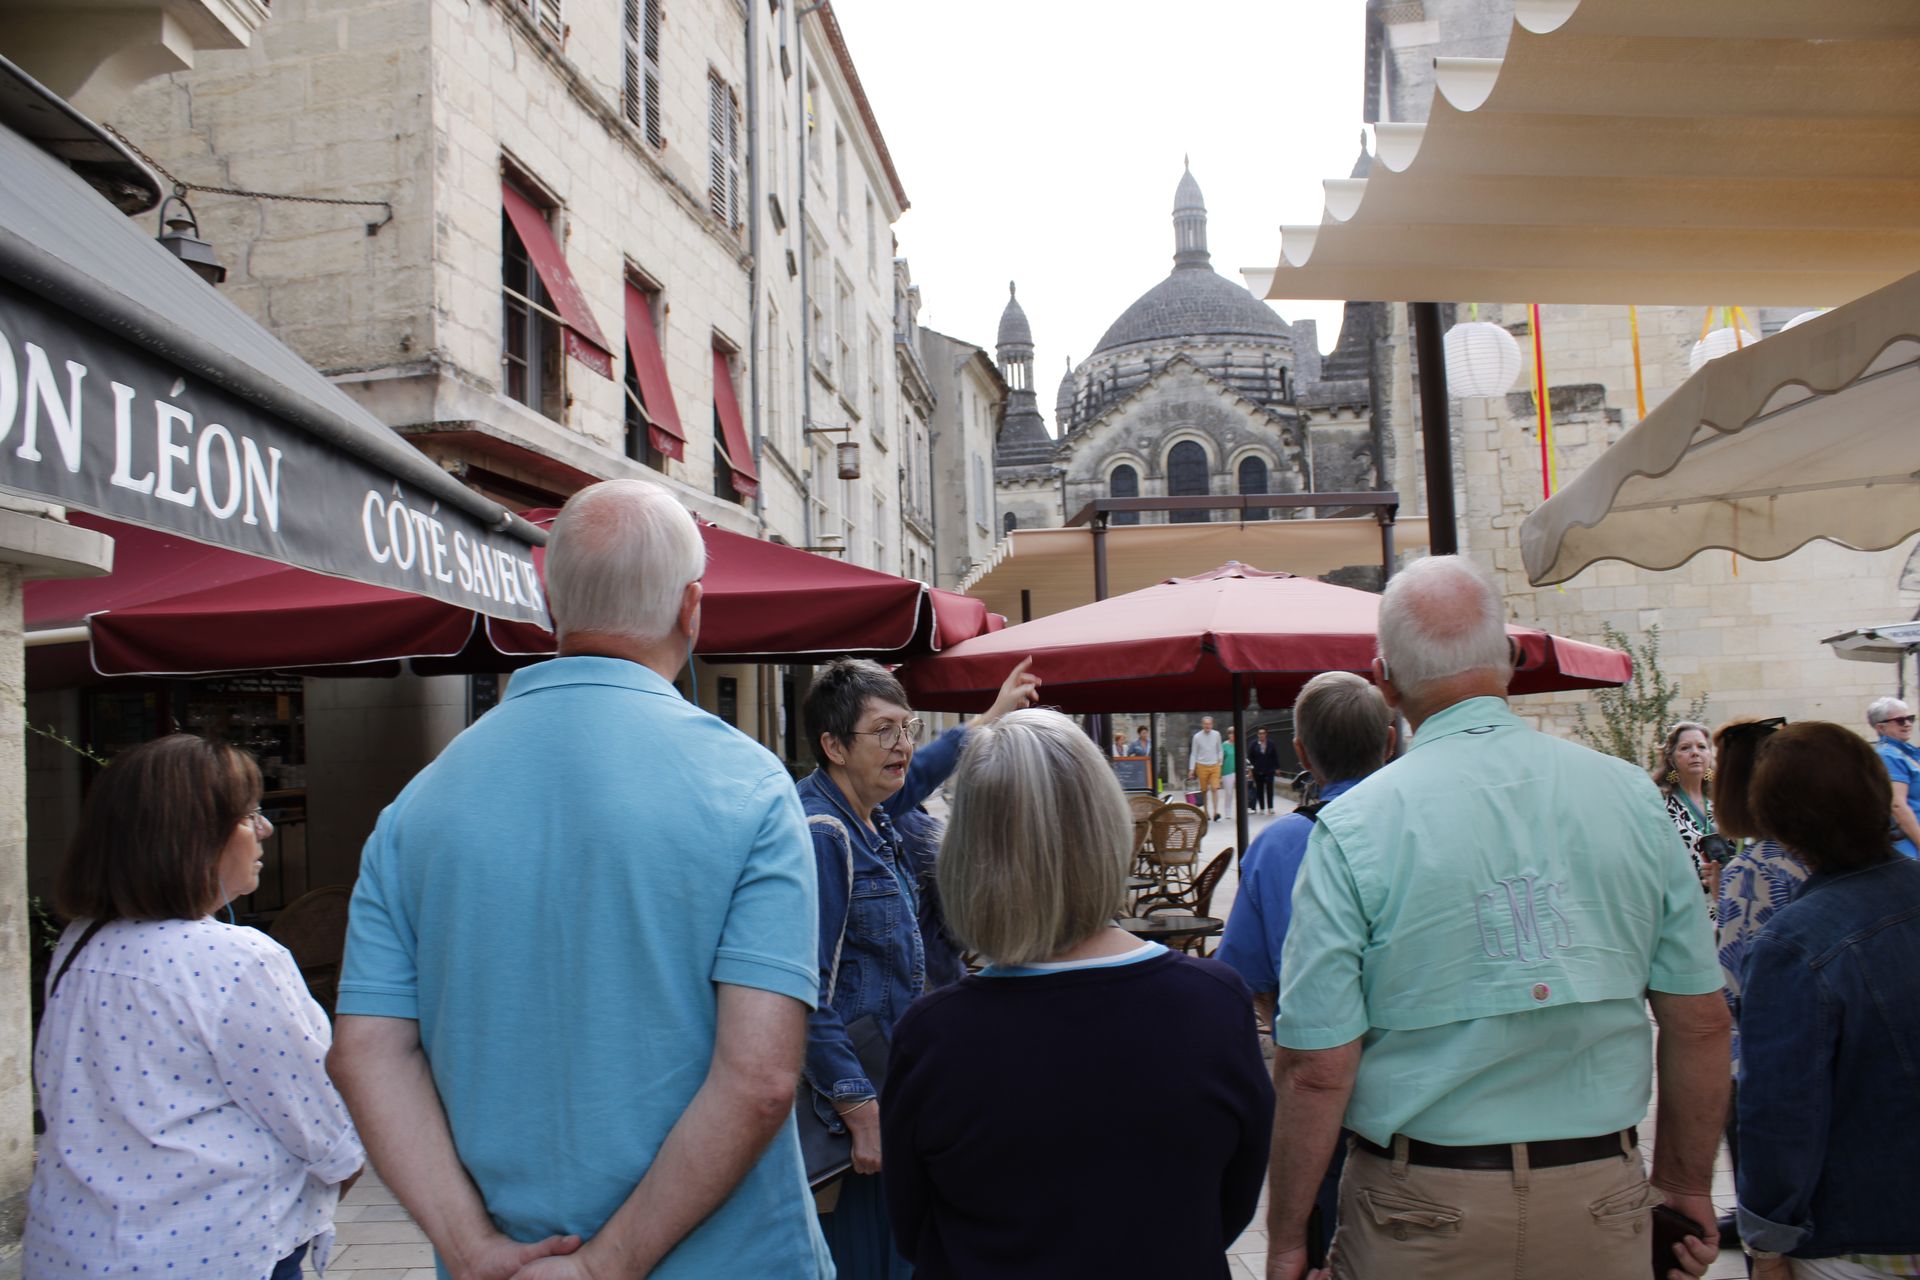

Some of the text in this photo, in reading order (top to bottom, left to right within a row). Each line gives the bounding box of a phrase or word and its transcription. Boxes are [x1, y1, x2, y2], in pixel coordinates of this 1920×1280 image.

[110, 376, 282, 533] LÉON
[362, 480, 544, 612] CÔTÉ SAVEUR
